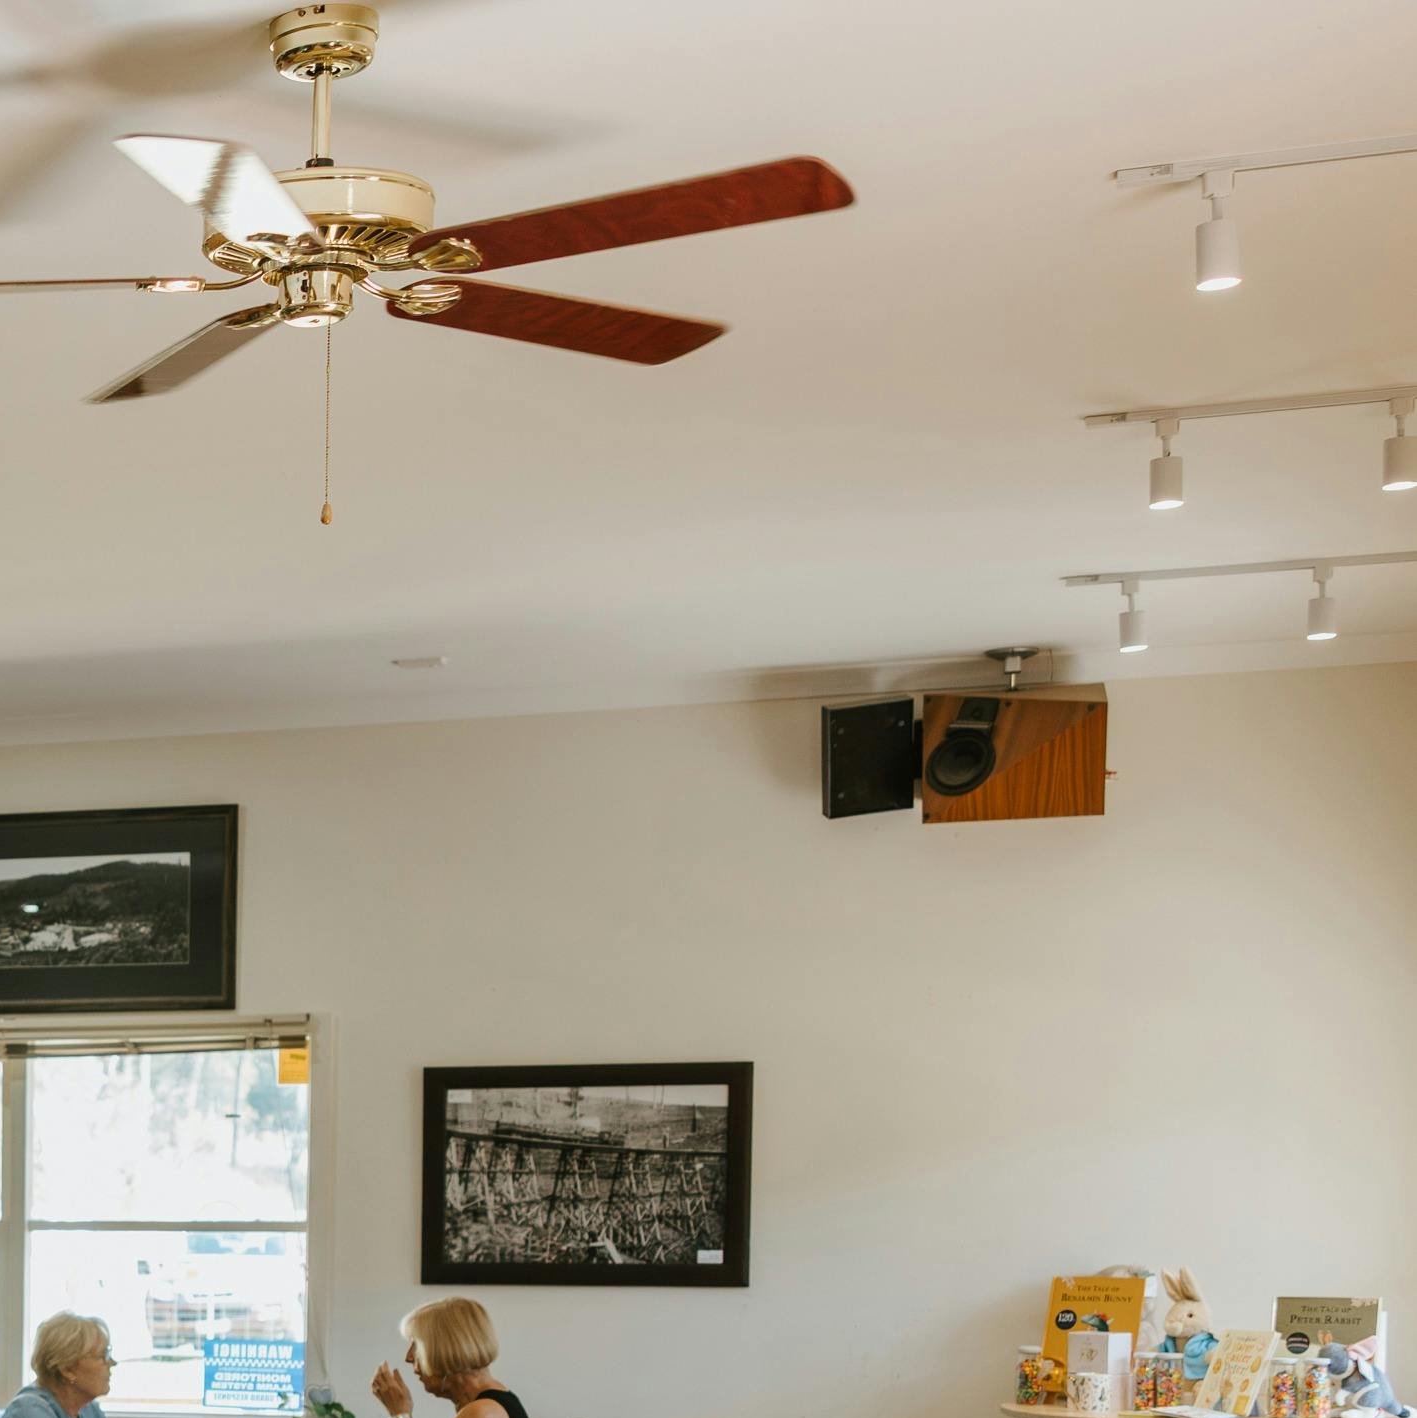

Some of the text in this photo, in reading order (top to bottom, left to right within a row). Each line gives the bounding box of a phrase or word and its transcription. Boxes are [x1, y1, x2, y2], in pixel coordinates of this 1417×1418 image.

[1061, 1293, 1133, 1303] BENJAMIN BUNNY
[1290, 1314, 1363, 1326] PETER RABBIT
